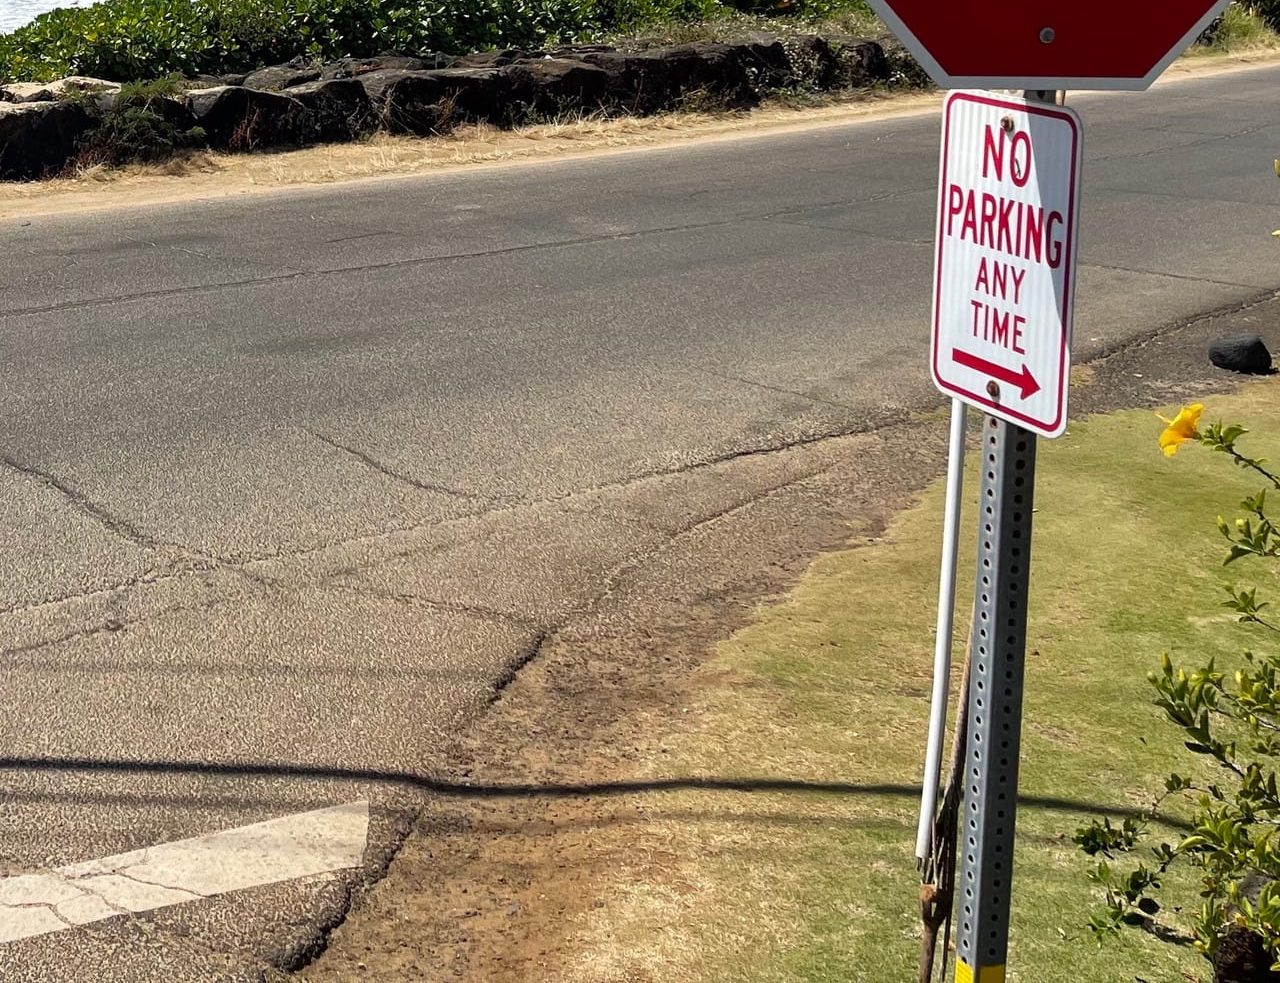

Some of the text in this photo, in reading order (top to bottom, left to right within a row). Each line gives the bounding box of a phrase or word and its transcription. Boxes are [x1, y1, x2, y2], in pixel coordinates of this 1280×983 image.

[982, 124, 1032, 187] NO
[947, 184, 1064, 269] PARKING
[974, 256, 1026, 305] ANY
[970, 300, 1026, 355] TIME
